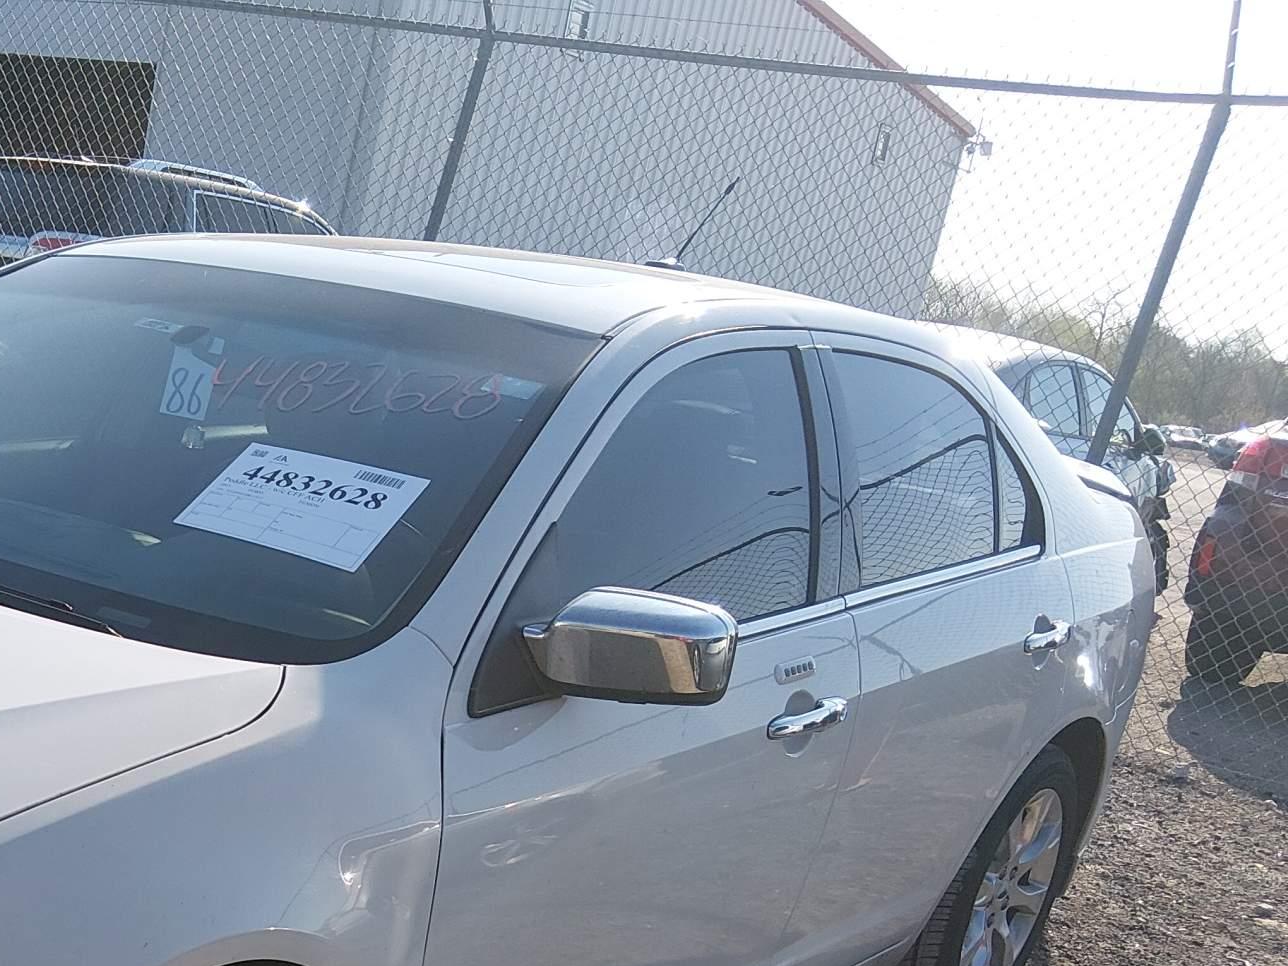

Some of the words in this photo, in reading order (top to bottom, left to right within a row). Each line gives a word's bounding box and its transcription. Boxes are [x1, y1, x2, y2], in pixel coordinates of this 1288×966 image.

[166, 366, 203, 415] 86
[211, 358, 503, 420] 44832628
[242, 465, 389, 510] 44832628
